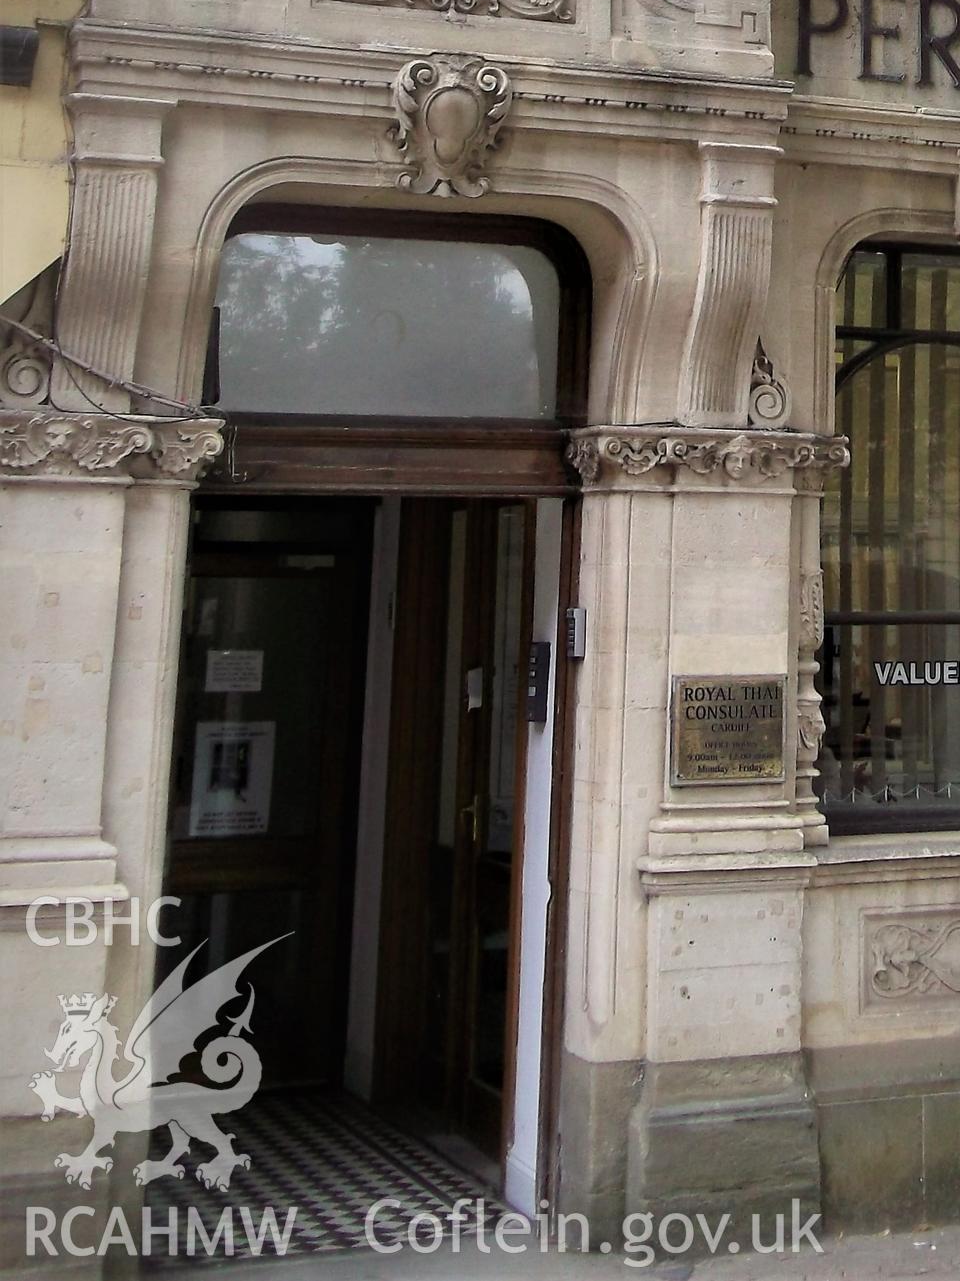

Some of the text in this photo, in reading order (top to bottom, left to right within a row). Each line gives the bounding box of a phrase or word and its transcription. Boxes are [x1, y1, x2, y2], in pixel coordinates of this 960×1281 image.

[685, 686, 779, 702] ROYAL THAI
[686, 705, 777, 720] CONSULATE
